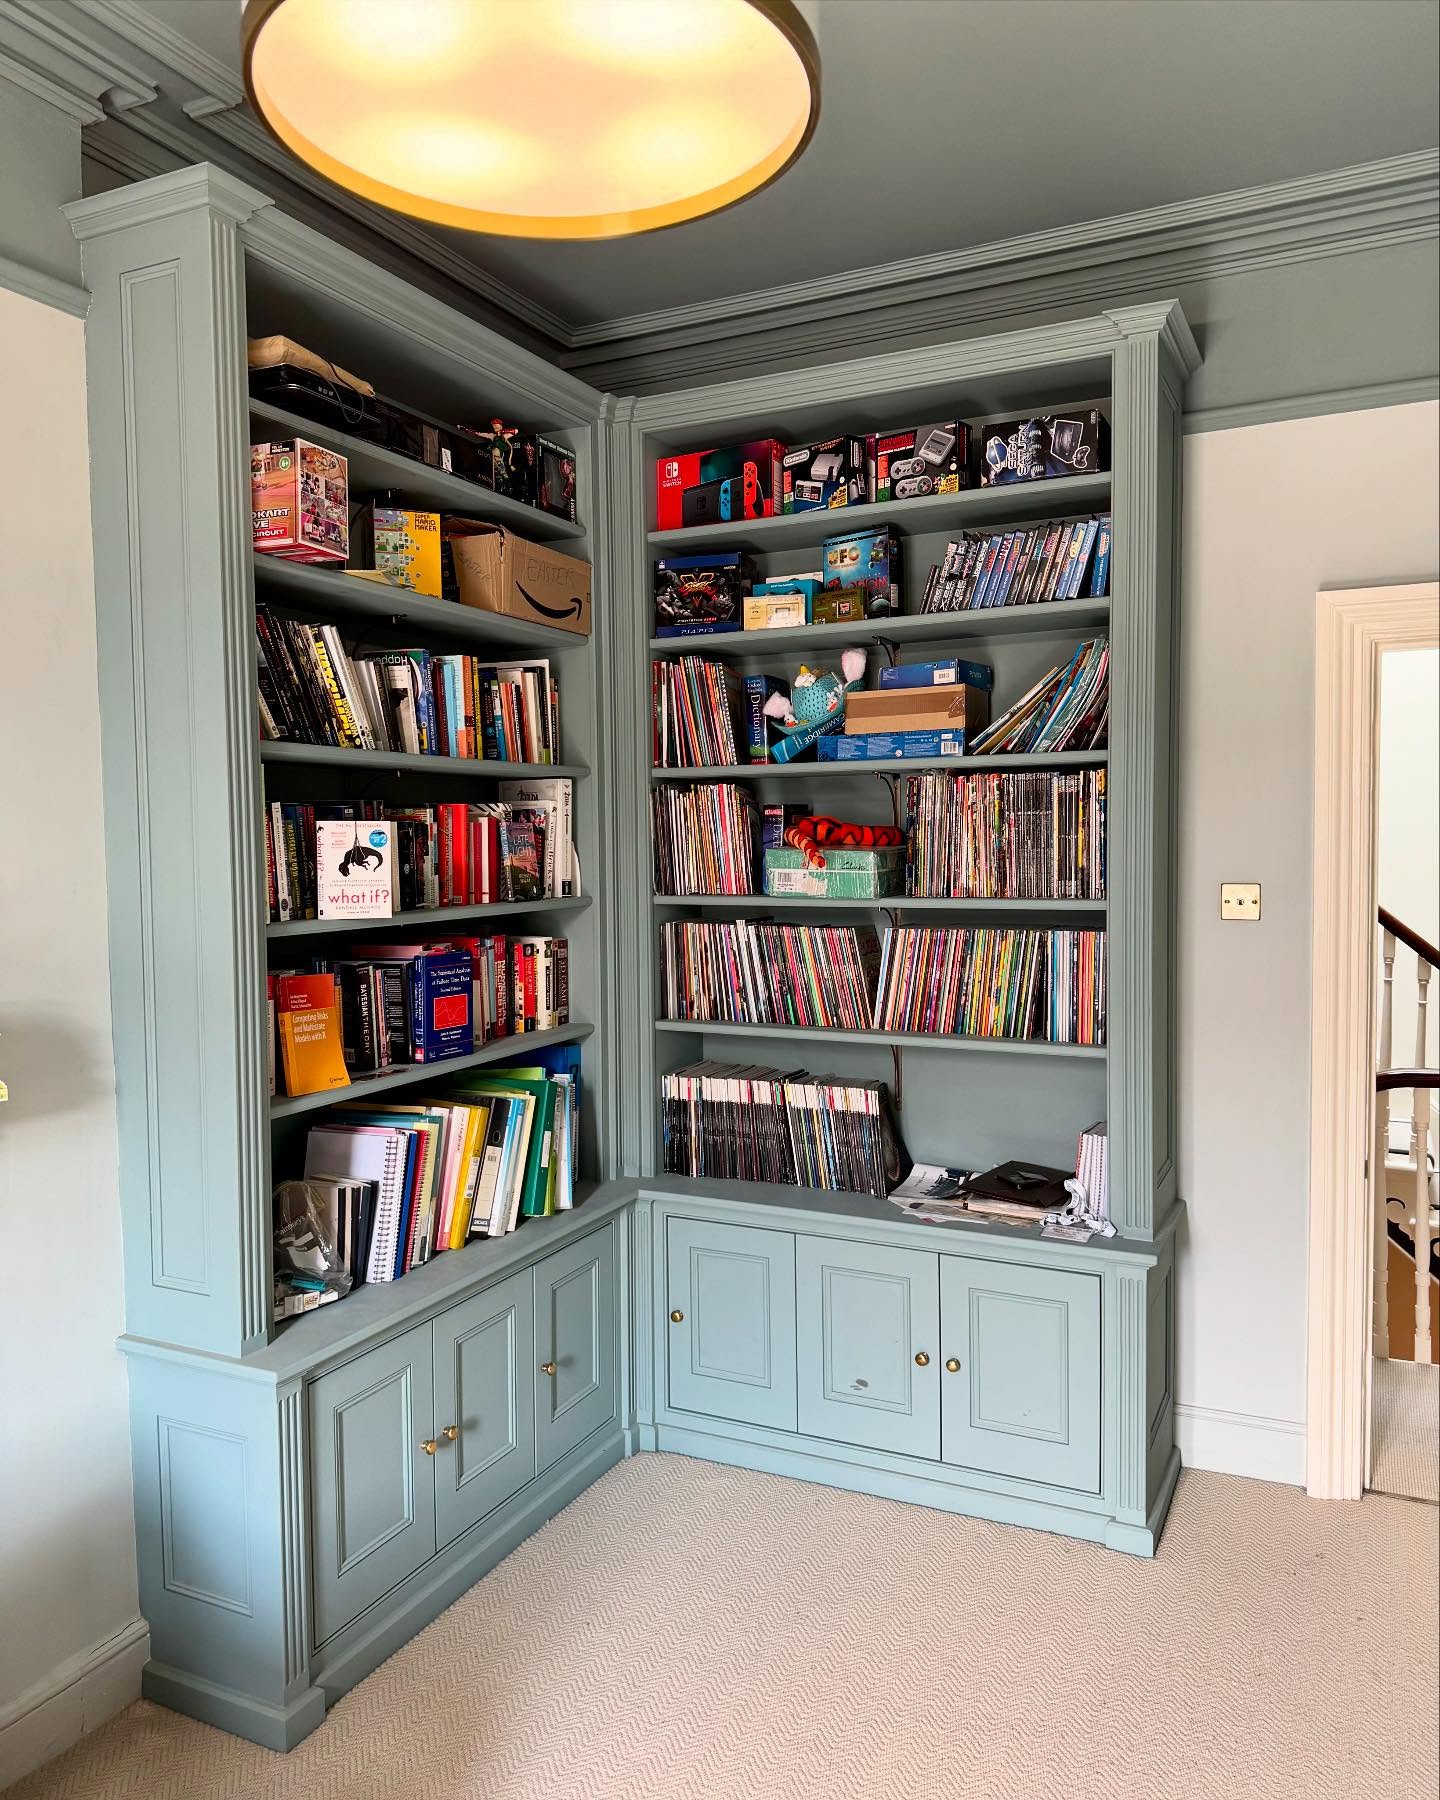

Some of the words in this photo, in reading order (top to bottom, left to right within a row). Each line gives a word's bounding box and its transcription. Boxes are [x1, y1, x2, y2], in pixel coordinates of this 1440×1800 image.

[1008, 433, 1018, 469] SEGA
[1017, 424, 1028, 476] SATURN
[827, 546, 861, 566] UFO
[527, 558, 576, 587] EASTER
[342, 698, 359, 737] WATCHMEN
[750, 694, 762, 749] Dictionary
[804, 713, 845, 746] CAMBRIDGE
[513, 834, 529, 846] LATE
[512, 846, 532, 857] LIGHT
[291, 860, 299, 877] DOOM
[328, 889, 366, 904] what
[370, 889, 389, 904] if?
[560, 961, 566, 975] 3D
[360, 984, 368, 1017] BAYESIAN
[293, 1014, 317, 1023] Competing
[317, 1012, 329, 1021] Risks
[294, 1034, 311, 1043] Models
[311, 1033, 322, 1041] with
[303, 1023, 326, 1033] Multistate
[363, 1017, 371, 1054] THEORY
[279, 1215, 306, 1236] ainsbury's
